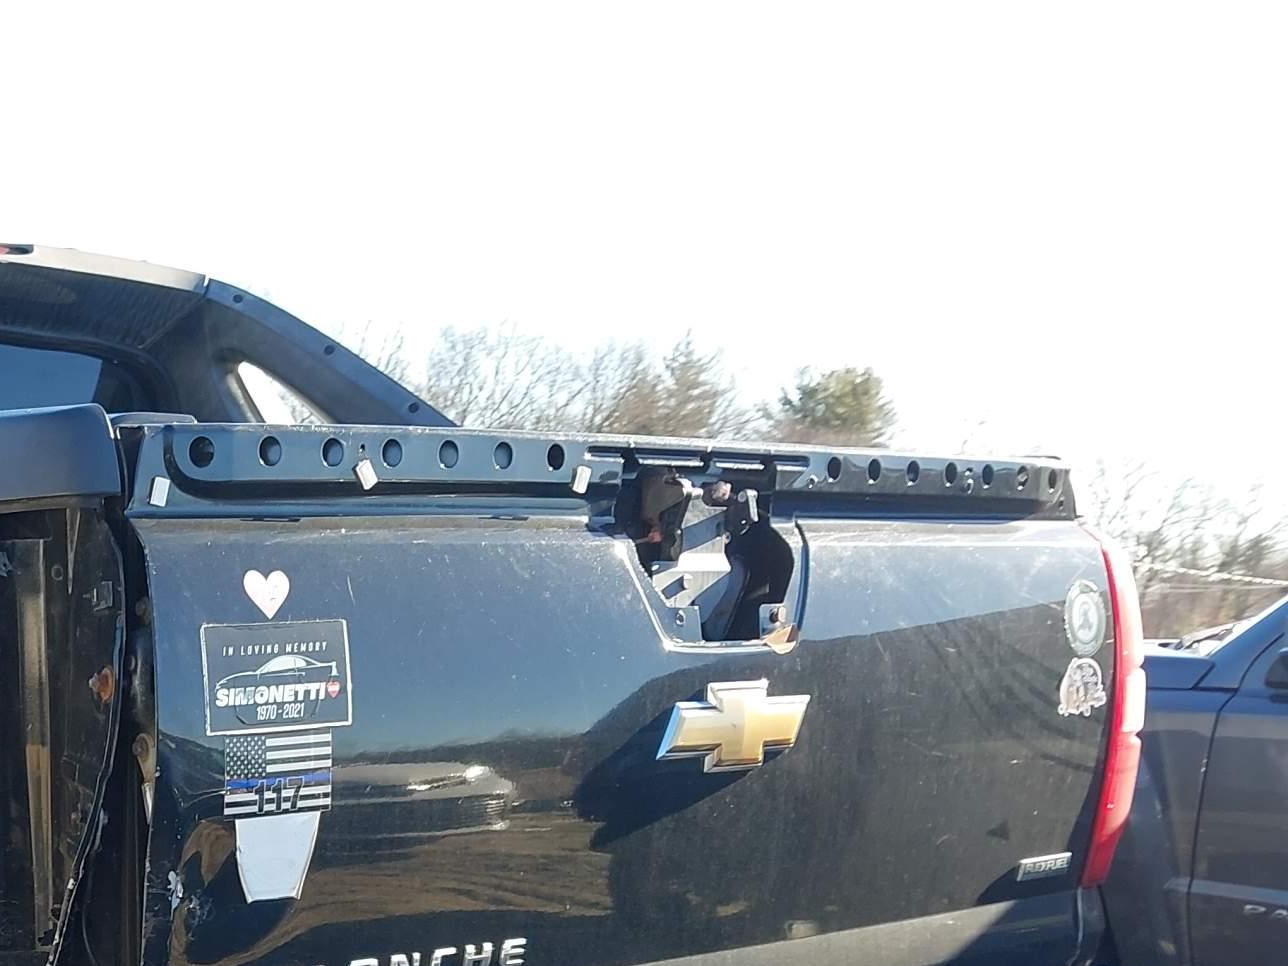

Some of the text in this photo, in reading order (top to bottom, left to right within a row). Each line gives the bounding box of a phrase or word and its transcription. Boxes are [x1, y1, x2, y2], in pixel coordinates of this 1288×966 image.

[222, 641, 328, 656] IN LOVING MEMORY
[215, 681, 327, 708] SIMONETTI
[253, 775, 305, 815] 117
